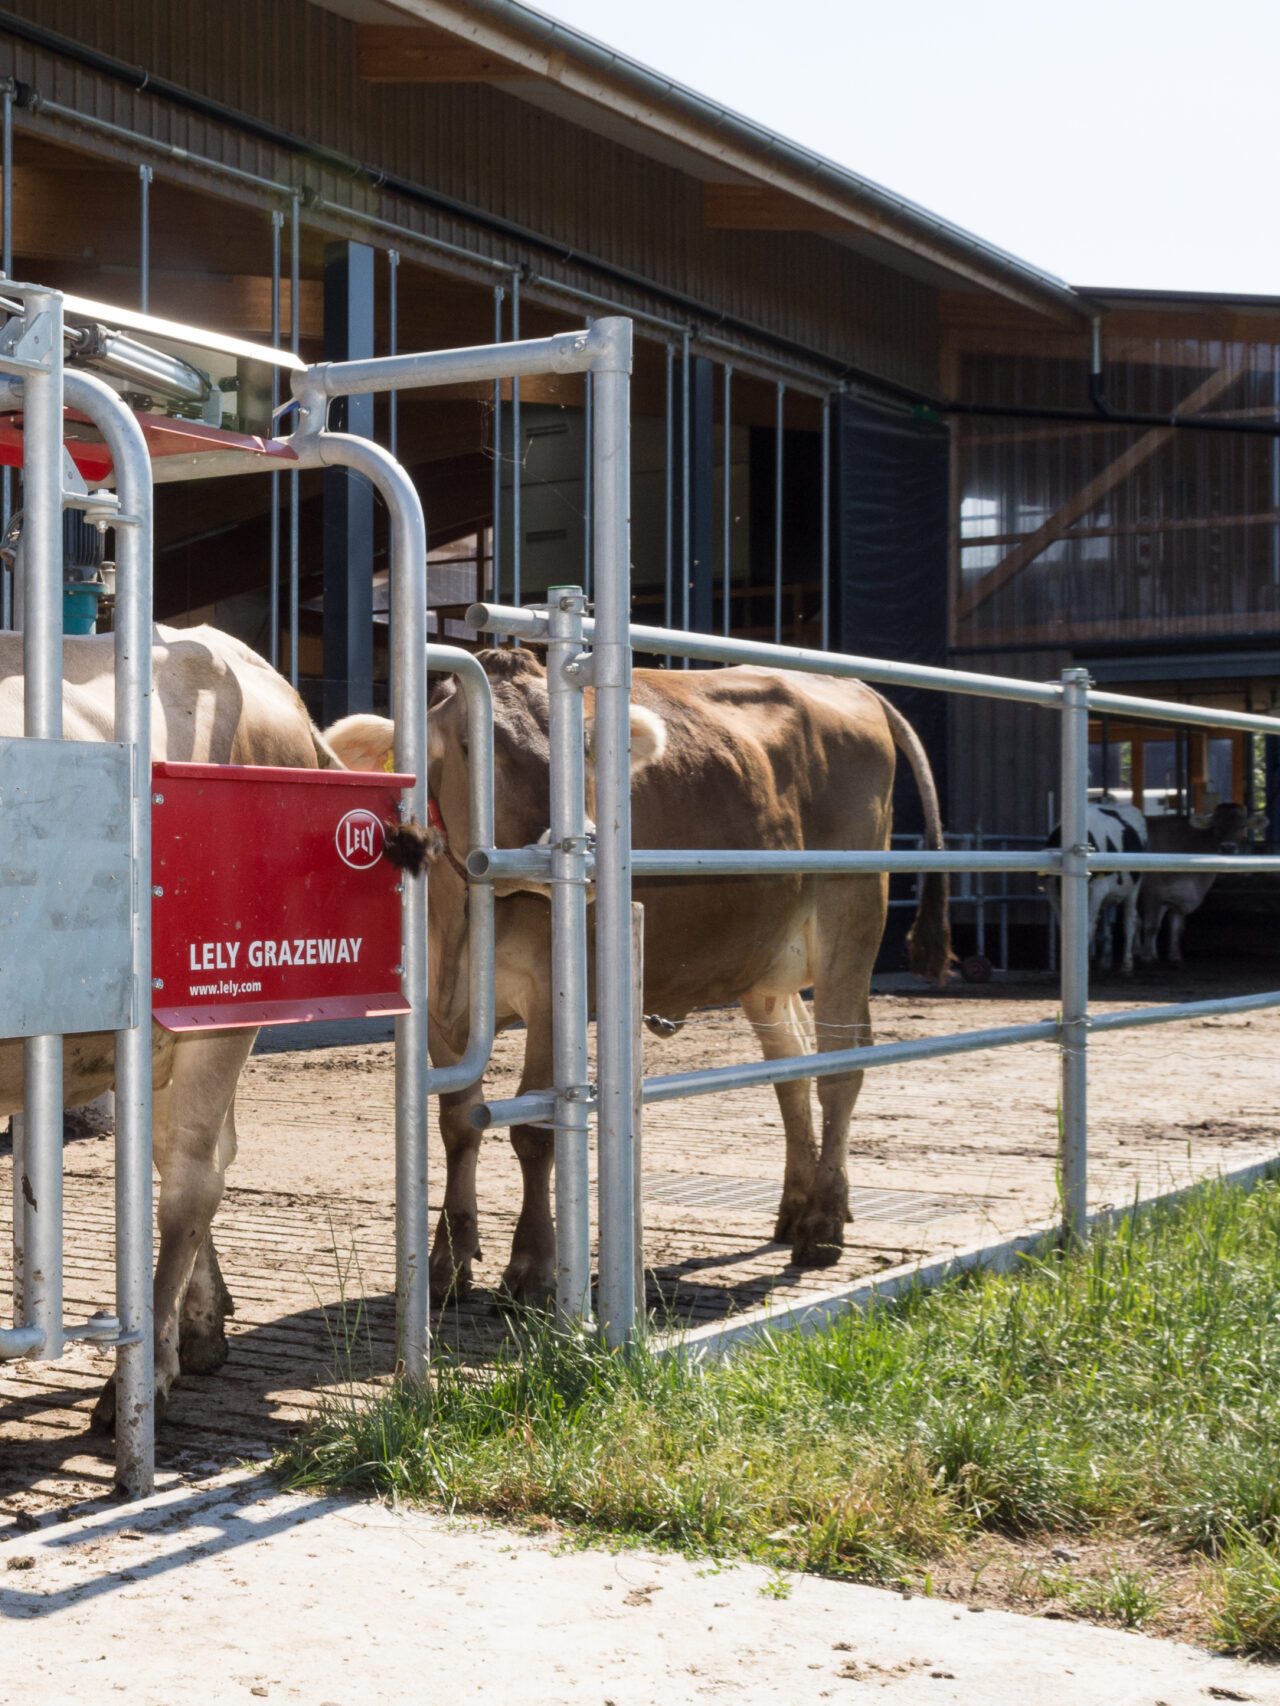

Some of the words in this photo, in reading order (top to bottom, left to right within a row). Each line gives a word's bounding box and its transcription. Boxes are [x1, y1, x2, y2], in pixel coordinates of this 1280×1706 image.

[346, 821, 375, 857] LELY
[190, 942, 240, 971] LELY
[248, 938, 362, 968] GRAZEWAY
[189, 980, 262, 997] www.lely.com
